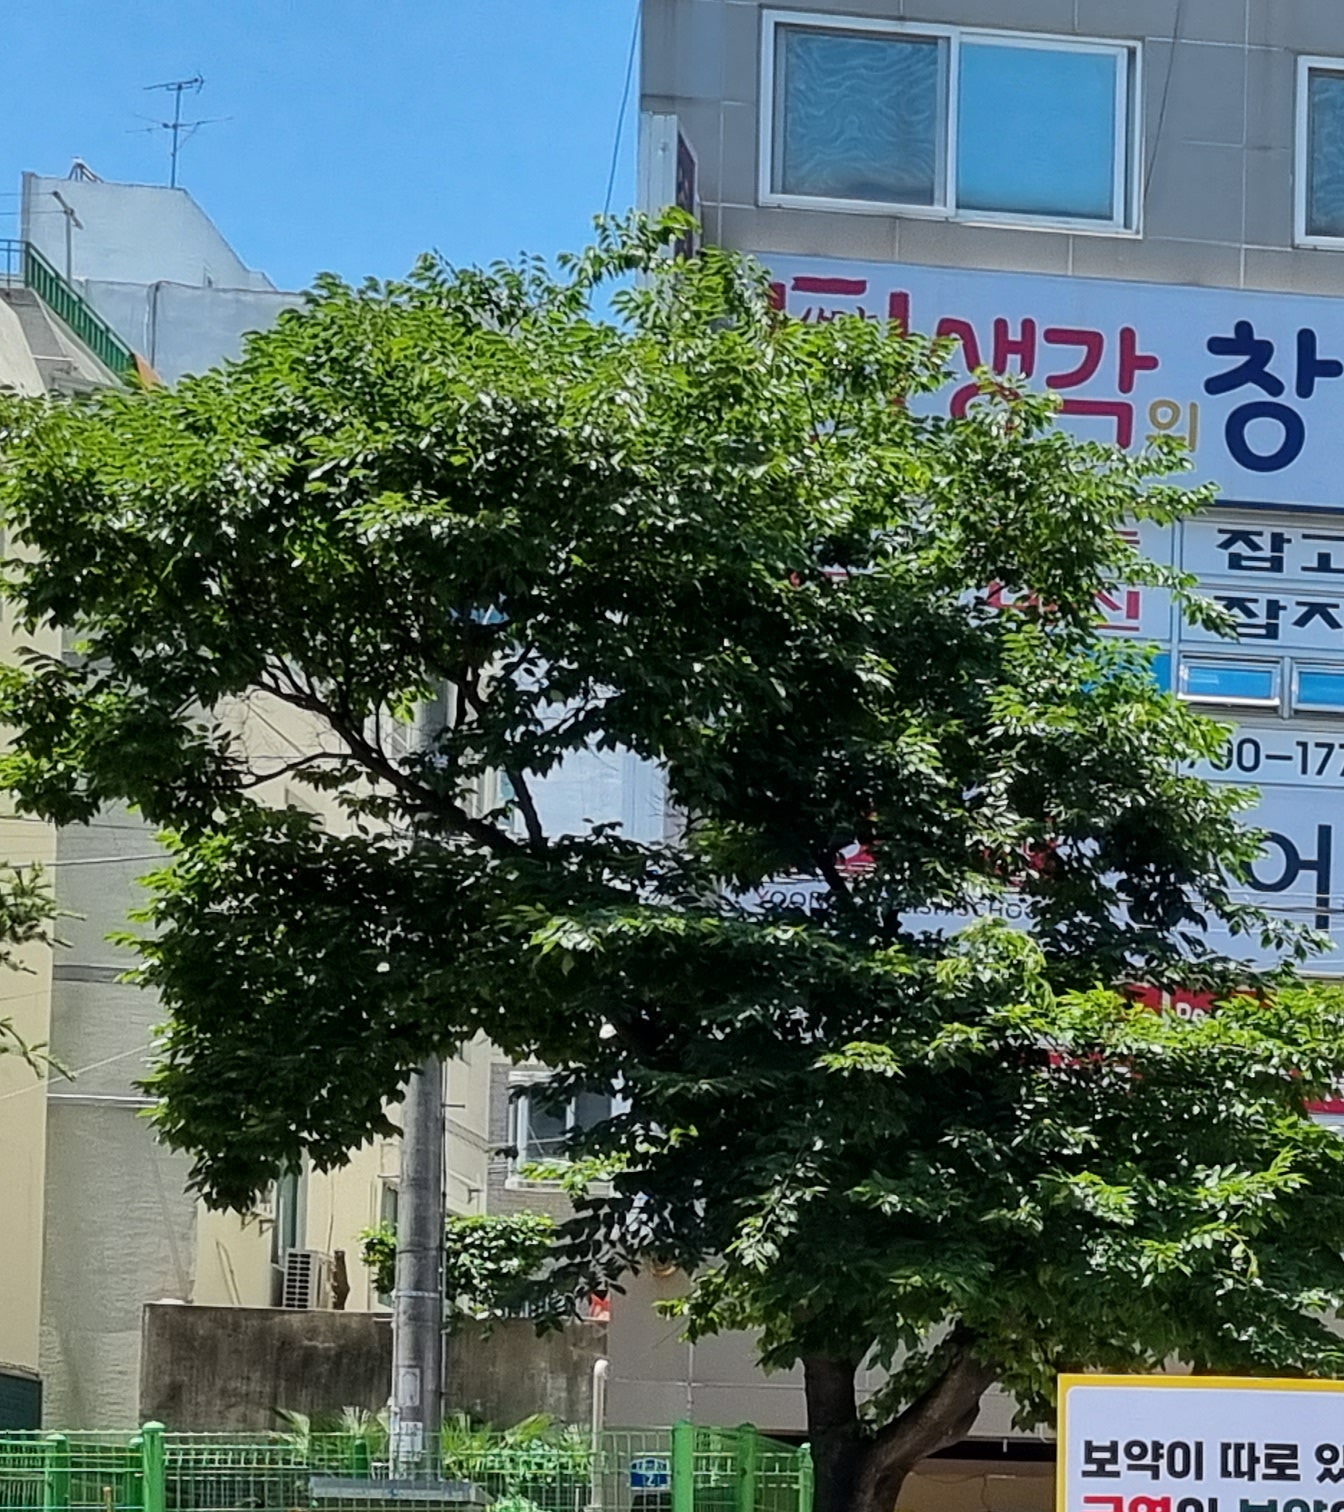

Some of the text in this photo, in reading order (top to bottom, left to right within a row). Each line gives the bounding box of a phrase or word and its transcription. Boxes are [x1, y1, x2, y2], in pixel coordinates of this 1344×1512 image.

[1205, 321, 1344, 472] 창
[1081, 1439, 1204, 1480] 보약이
[1219, 1441, 1301, 1482] 따로
